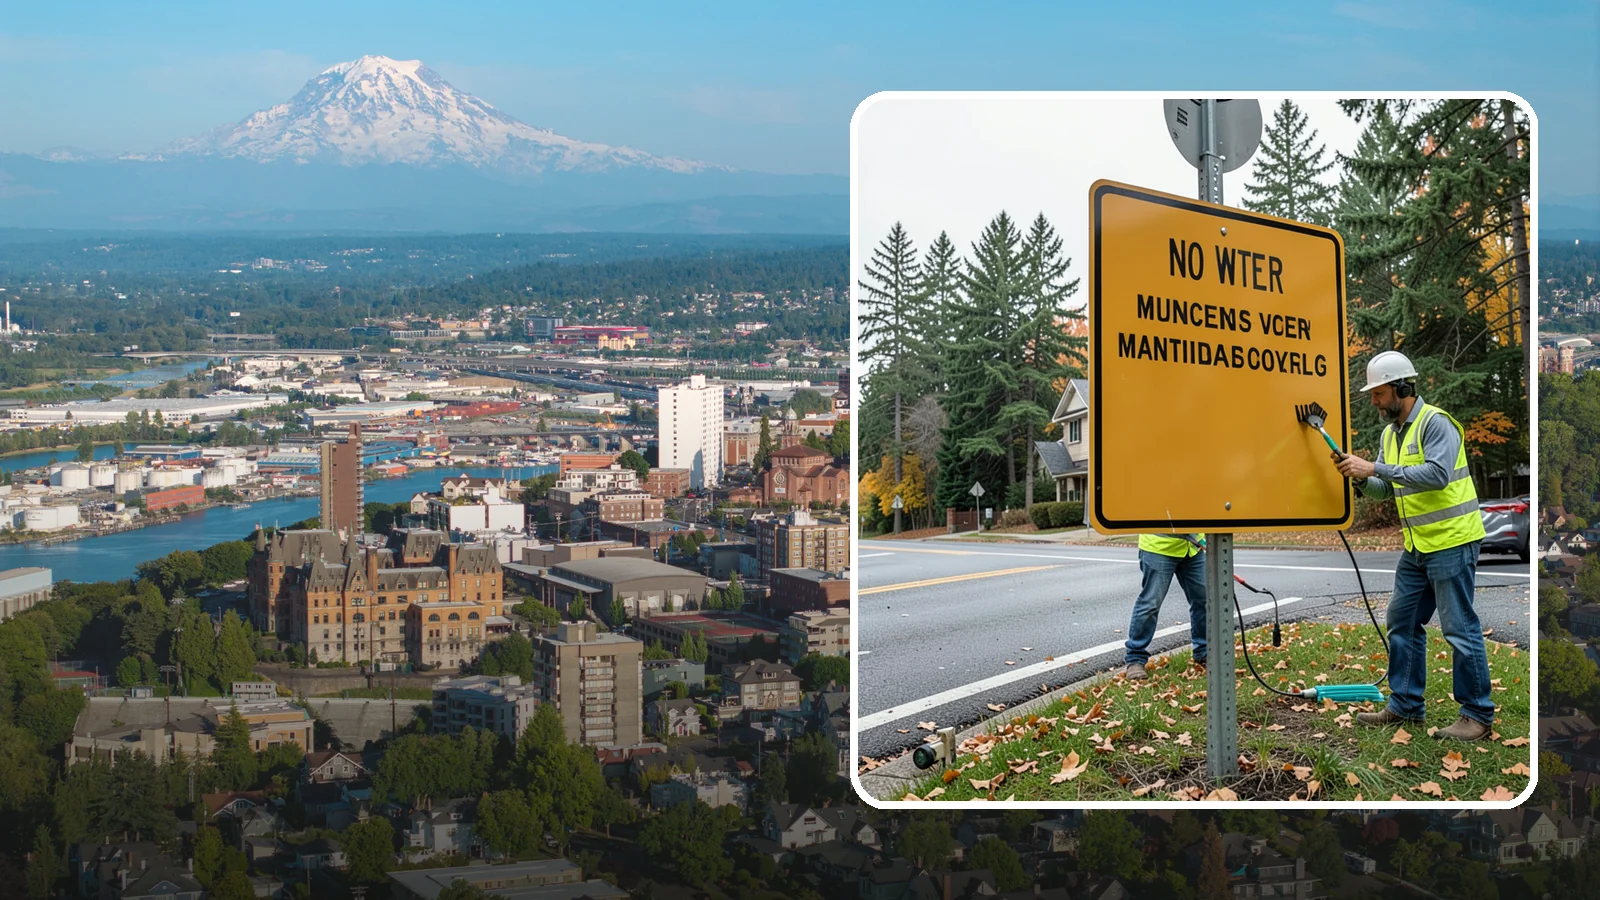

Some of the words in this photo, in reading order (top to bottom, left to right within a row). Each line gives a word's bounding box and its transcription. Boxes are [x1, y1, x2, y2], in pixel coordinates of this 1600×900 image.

[1169, 238, 1204, 280] NO
[1215, 245, 1284, 294] WTER
[1137, 294, 1252, 333] MUNCENS
